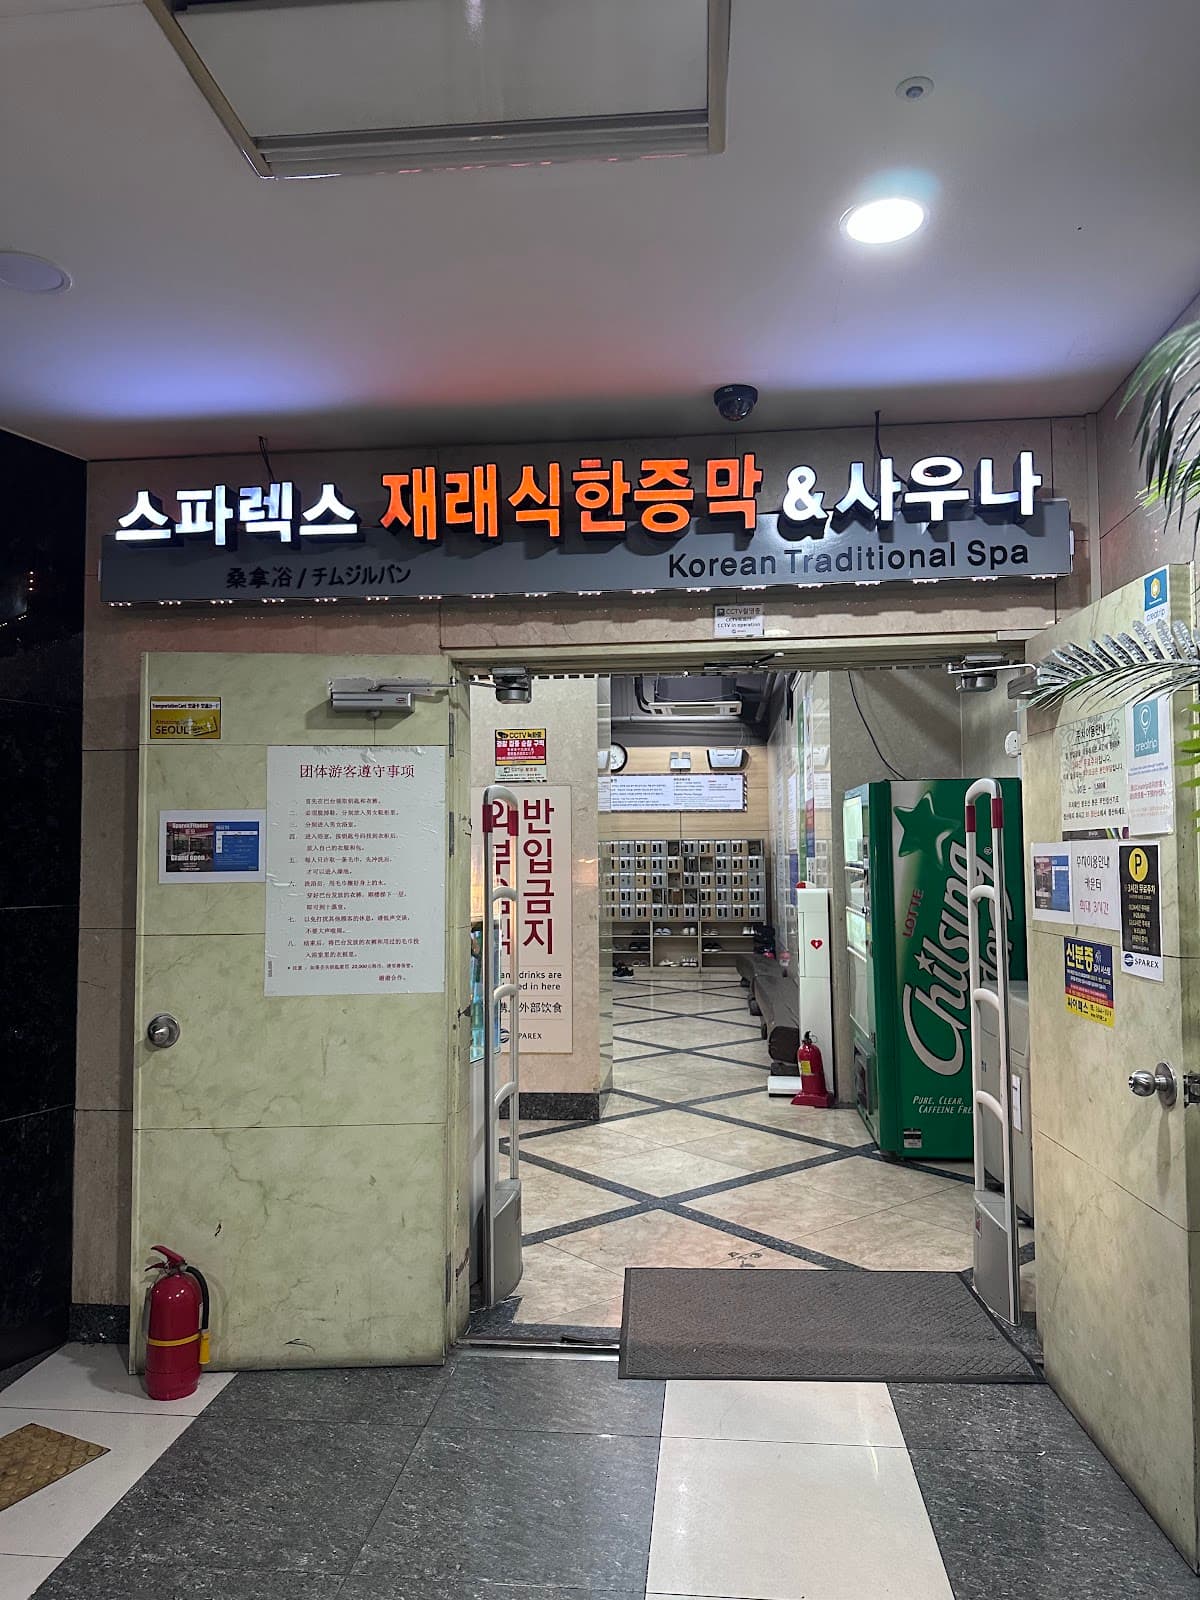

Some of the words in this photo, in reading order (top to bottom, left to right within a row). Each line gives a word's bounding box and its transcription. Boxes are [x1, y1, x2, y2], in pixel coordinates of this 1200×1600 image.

[114, 481, 358, 546] 스파렉스
[668, 551, 776, 578] Korean
[783, 542, 955, 575] Traditional
[966, 540, 1029, 569] Spa
[154, 725, 190, 735] SEOUL
[299, 764, 415, 779] 团体游客遵守事项
[189, 854, 205, 862] open
[522, 798, 555, 955] 반입금지
[902, 888, 924, 937] LOTTE
[1066, 942, 1094, 973] 신분증
[1134, 958, 1159, 969] SPAREX
[519, 970, 546, 979] drinks
[530, 982, 539, 990] in
[541, 982, 561, 990] here
[517, 1032, 542, 1040] PAREX
[912, 1095, 935, 1105] PURE.
[938, 1095, 964, 1105] CLEAR.
[918, 1104, 954, 1114] CAFFEINE
[957, 1105, 974, 1114] FRE
